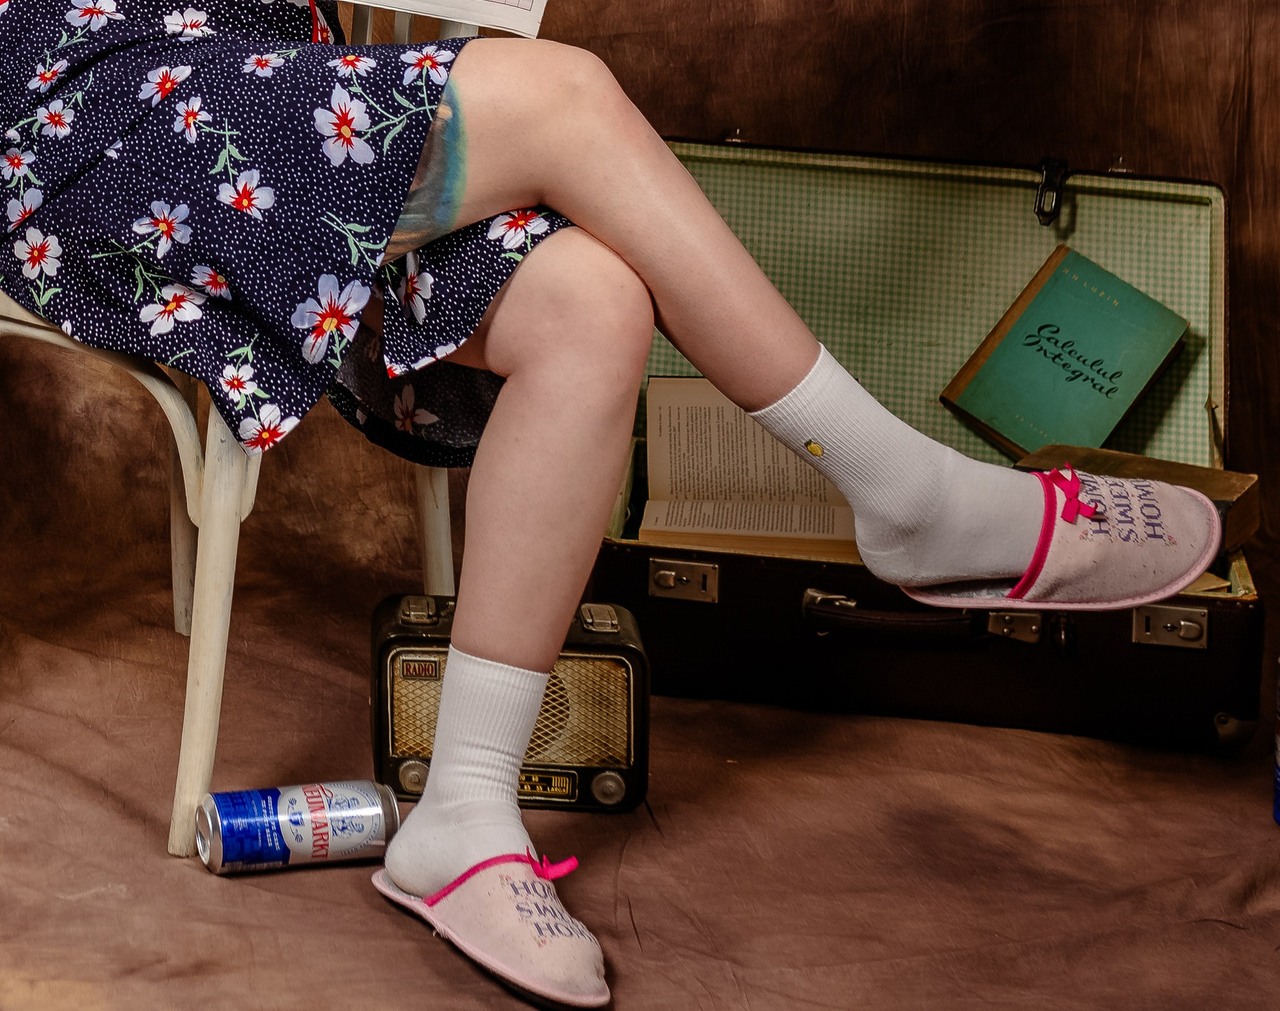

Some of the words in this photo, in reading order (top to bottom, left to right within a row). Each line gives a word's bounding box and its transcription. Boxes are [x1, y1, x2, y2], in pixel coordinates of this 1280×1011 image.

[1022, 334, 1118, 399] Integral
[1037, 324, 1123, 384] Calculul
[406, 662, 434, 676] RADIO
